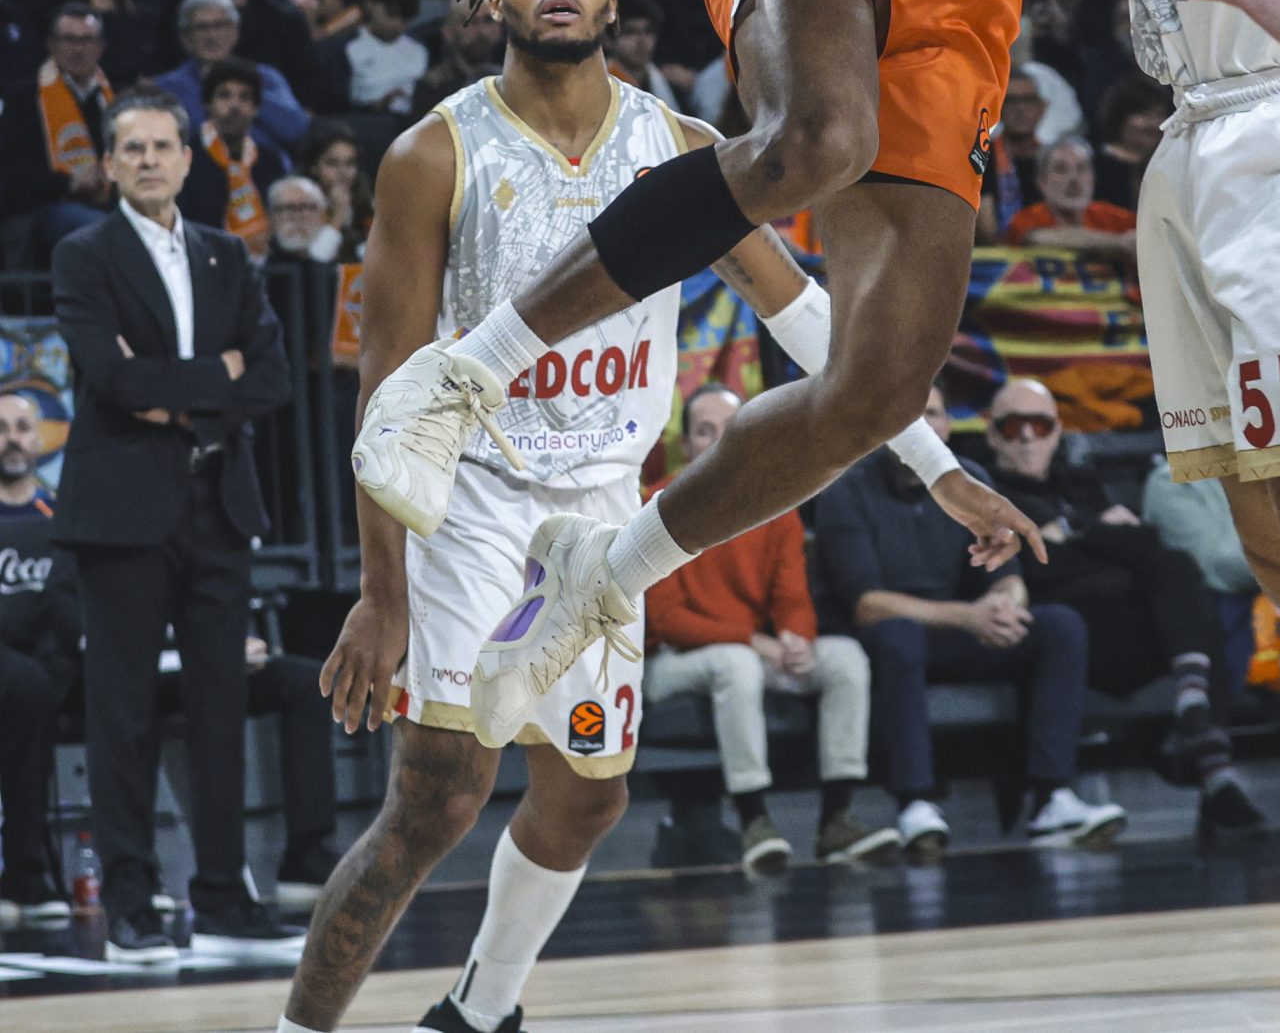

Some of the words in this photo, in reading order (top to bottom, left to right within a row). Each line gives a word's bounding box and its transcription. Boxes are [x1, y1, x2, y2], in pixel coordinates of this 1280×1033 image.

[509, 339, 651, 399] EDCOM
[1162, 407, 1206, 429] ONACO
[615, 683, 635, 752] 2
